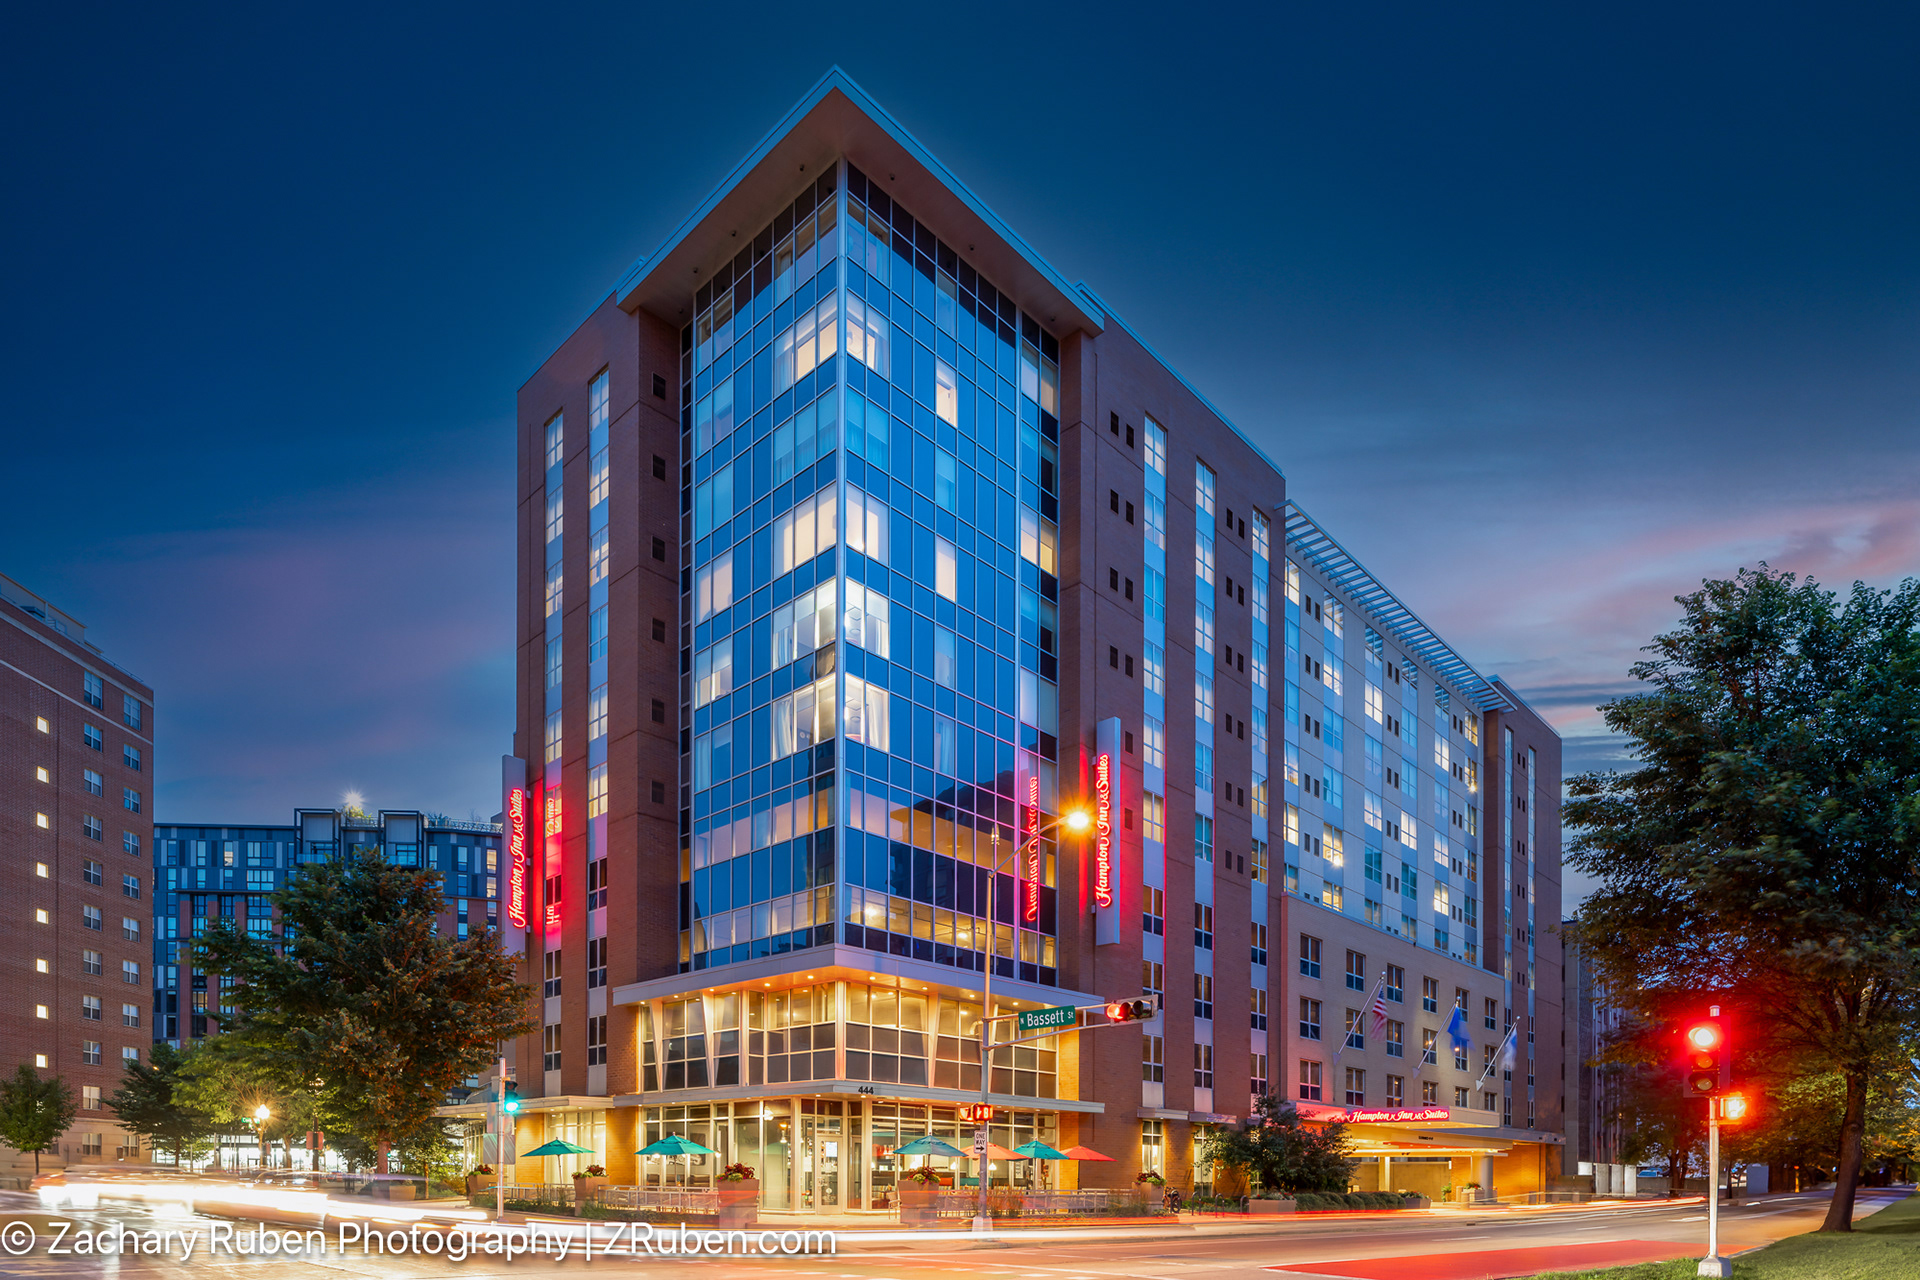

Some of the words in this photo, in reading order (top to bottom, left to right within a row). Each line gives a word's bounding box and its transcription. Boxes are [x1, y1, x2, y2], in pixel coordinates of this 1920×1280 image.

[1096, 754, 1109, 792] Suites
[510, 788, 523, 824] Suites
[1097, 801, 1110, 836] Inn
[510, 829, 525, 863] Inn
[1095, 837, 1112, 908] Hampton
[508, 863, 526, 928] Hampton
[1027, 1010, 1064, 1027] Bassett
[858, 1086, 874, 1095] 444
[1347, 1110, 1393, 1123] Hampton
[1391, 1110, 1416, 1121] Inn
[1422, 1109, 1449, 1119] Suites
